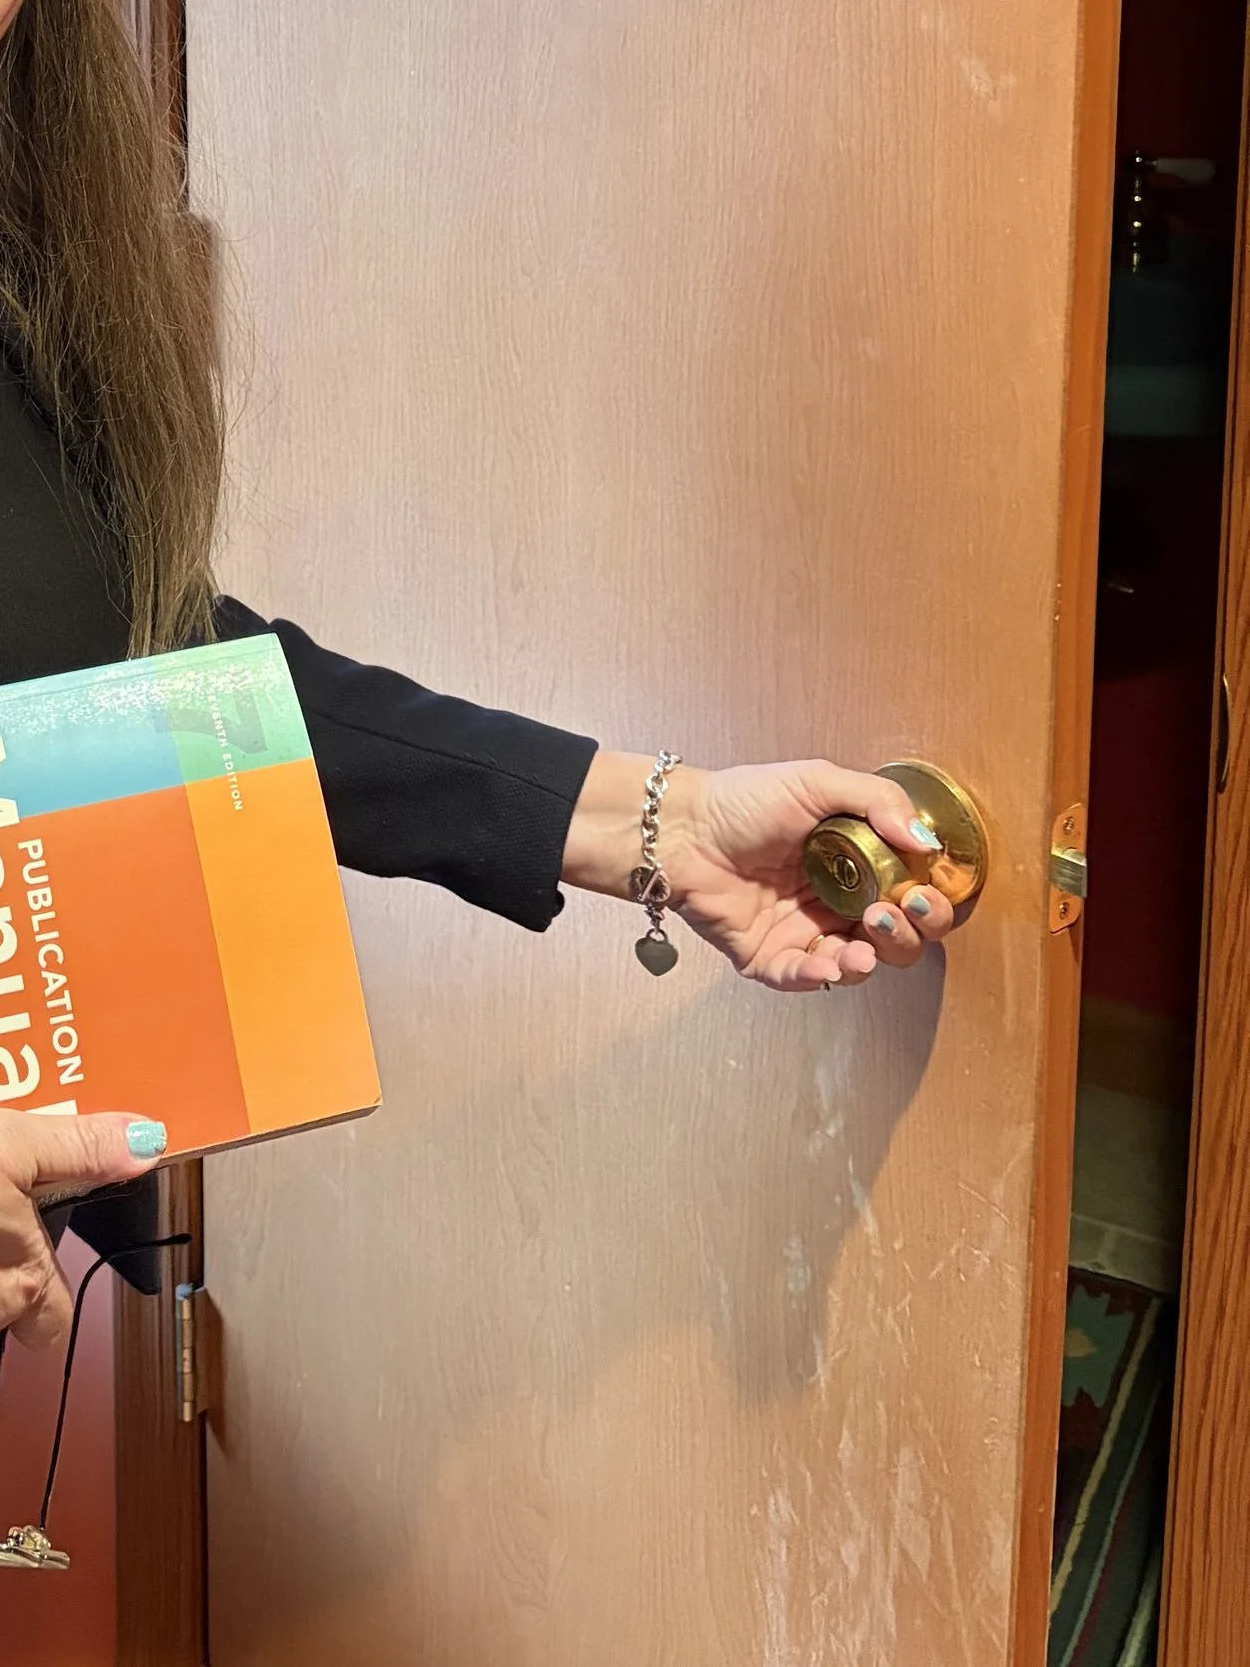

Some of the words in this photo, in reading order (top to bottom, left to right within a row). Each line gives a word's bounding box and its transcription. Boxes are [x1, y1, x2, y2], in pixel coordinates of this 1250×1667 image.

[205, 687, 228, 747] SEVENTH
[223, 753, 243, 810] EDITION
[17, 838, 85, 1086] PUBLICATION
